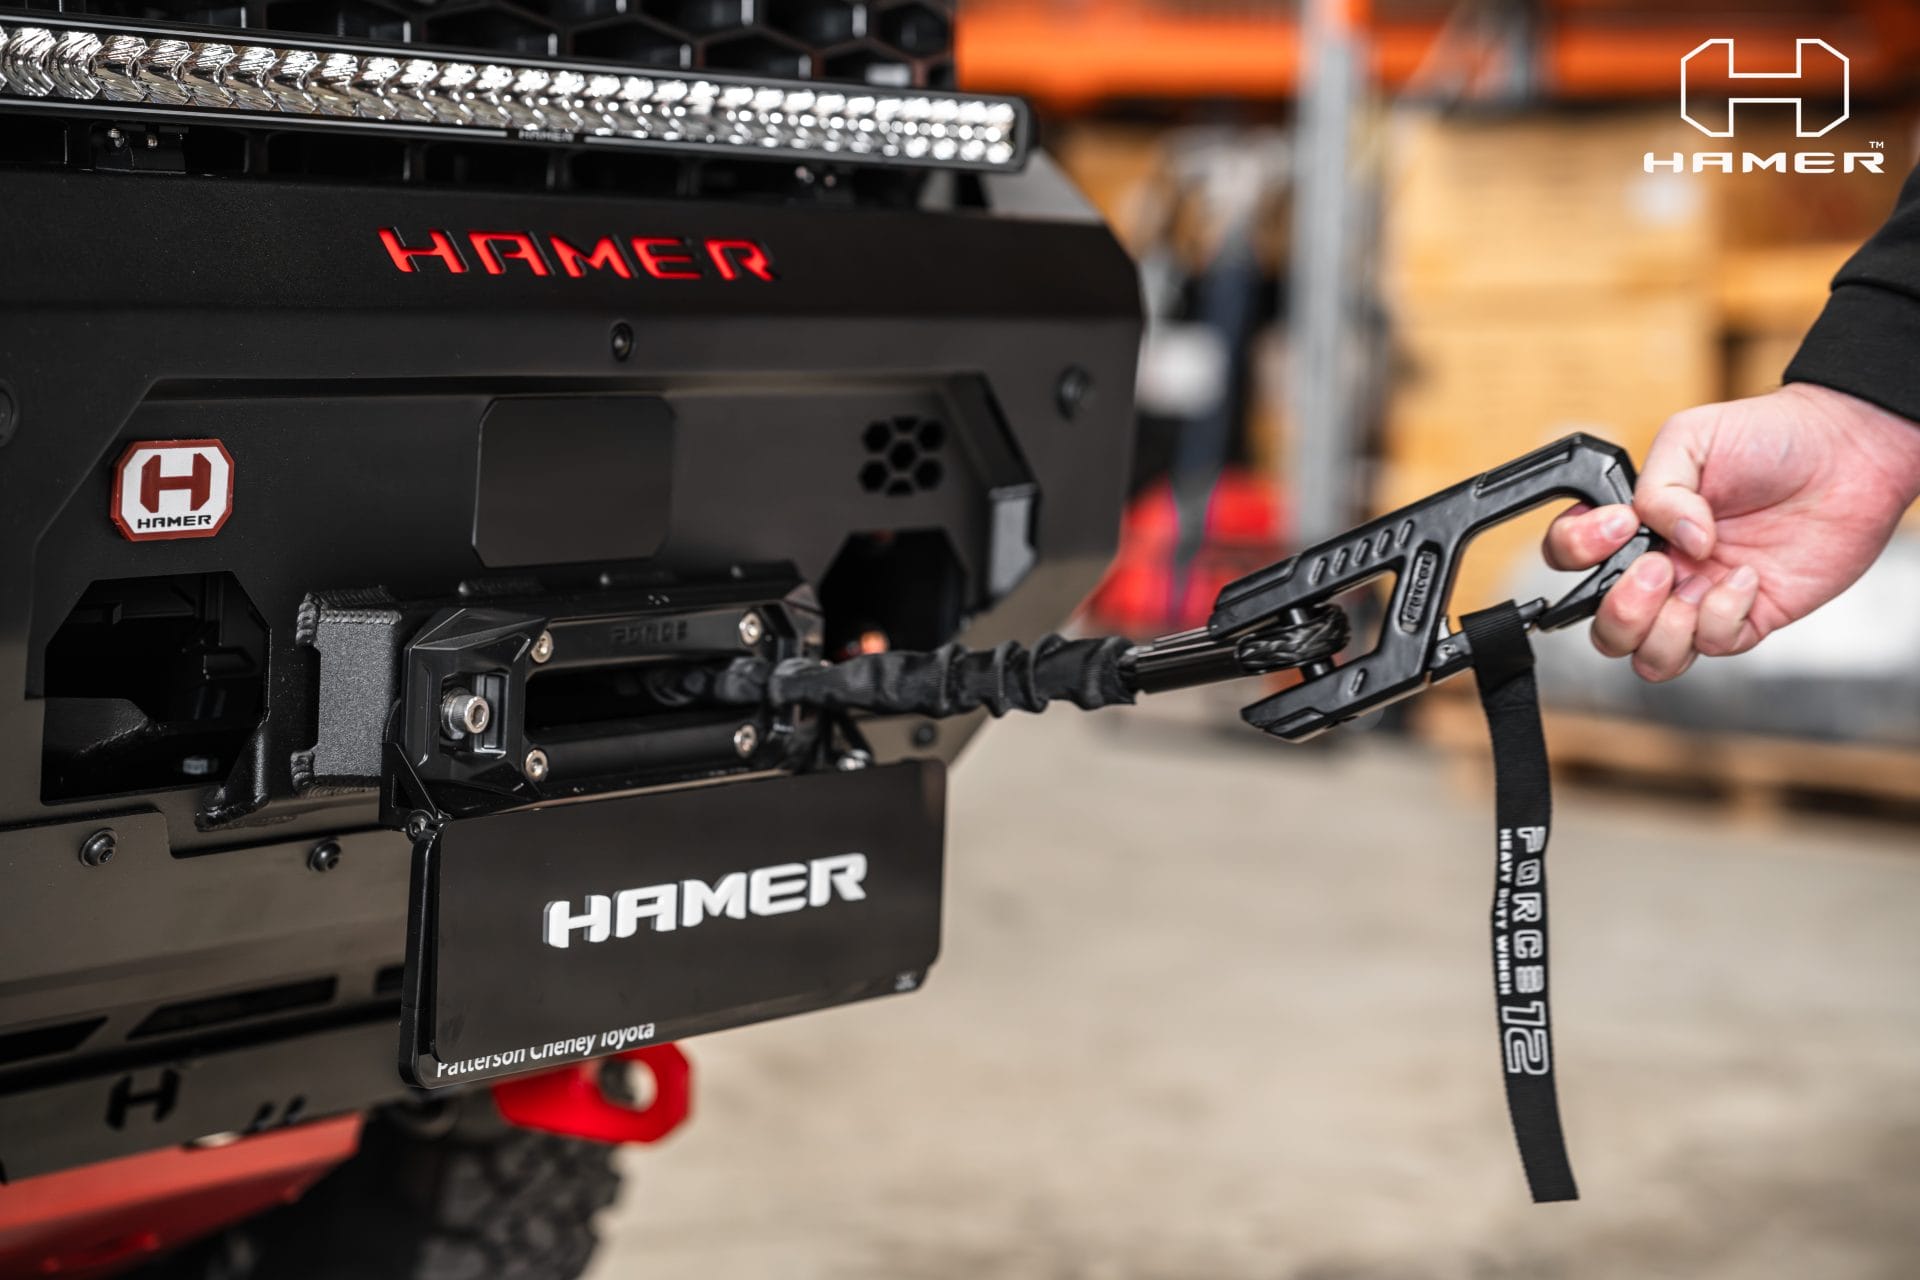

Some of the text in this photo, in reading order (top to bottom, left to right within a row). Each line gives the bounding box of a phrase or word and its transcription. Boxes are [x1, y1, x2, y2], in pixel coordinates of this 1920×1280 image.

[377, 226, 778, 281] HAMER
[137, 514, 212, 529] HAMER
[543, 852, 867, 949] HAMER
[1495, 828, 1513, 995] HEAVY DUTY WINCH
[436, 1047, 526, 1078] Patterson
[529, 1034, 596, 1060] Cheney
